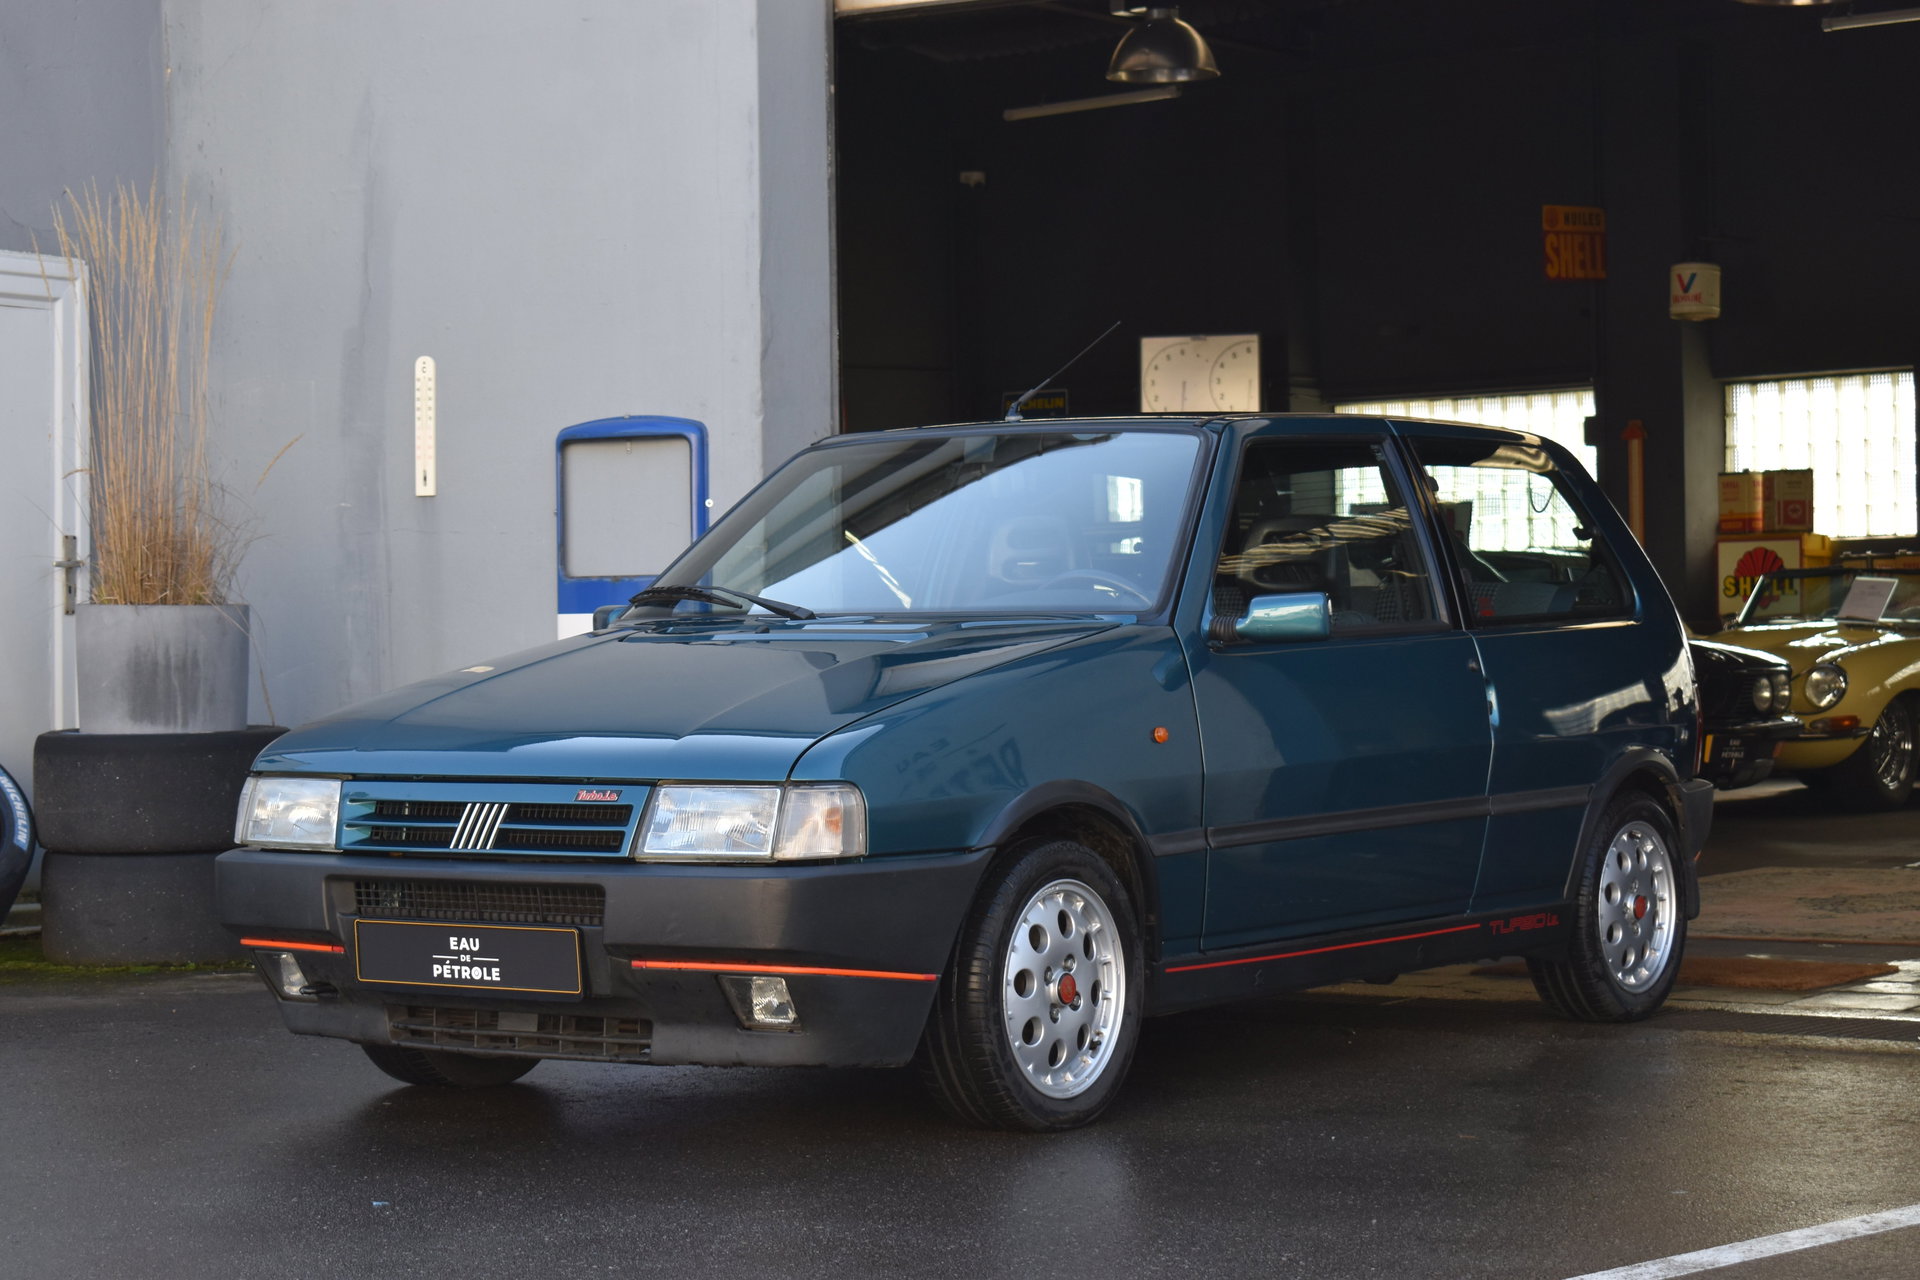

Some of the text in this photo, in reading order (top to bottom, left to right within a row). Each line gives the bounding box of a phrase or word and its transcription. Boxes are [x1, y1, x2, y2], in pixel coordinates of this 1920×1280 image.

[1564, 211, 1602, 227] HUILES
[1545, 232, 1607, 279] SHELL
[1676, 272, 1697, 294] V
[1723, 574, 1797, 598] SHLL
[1489, 913, 1547, 936] TURBO
[449, 936, 480, 951] EAU
[460, 954, 471, 962] DE
[432, 959, 501, 981] PÉTROLE
